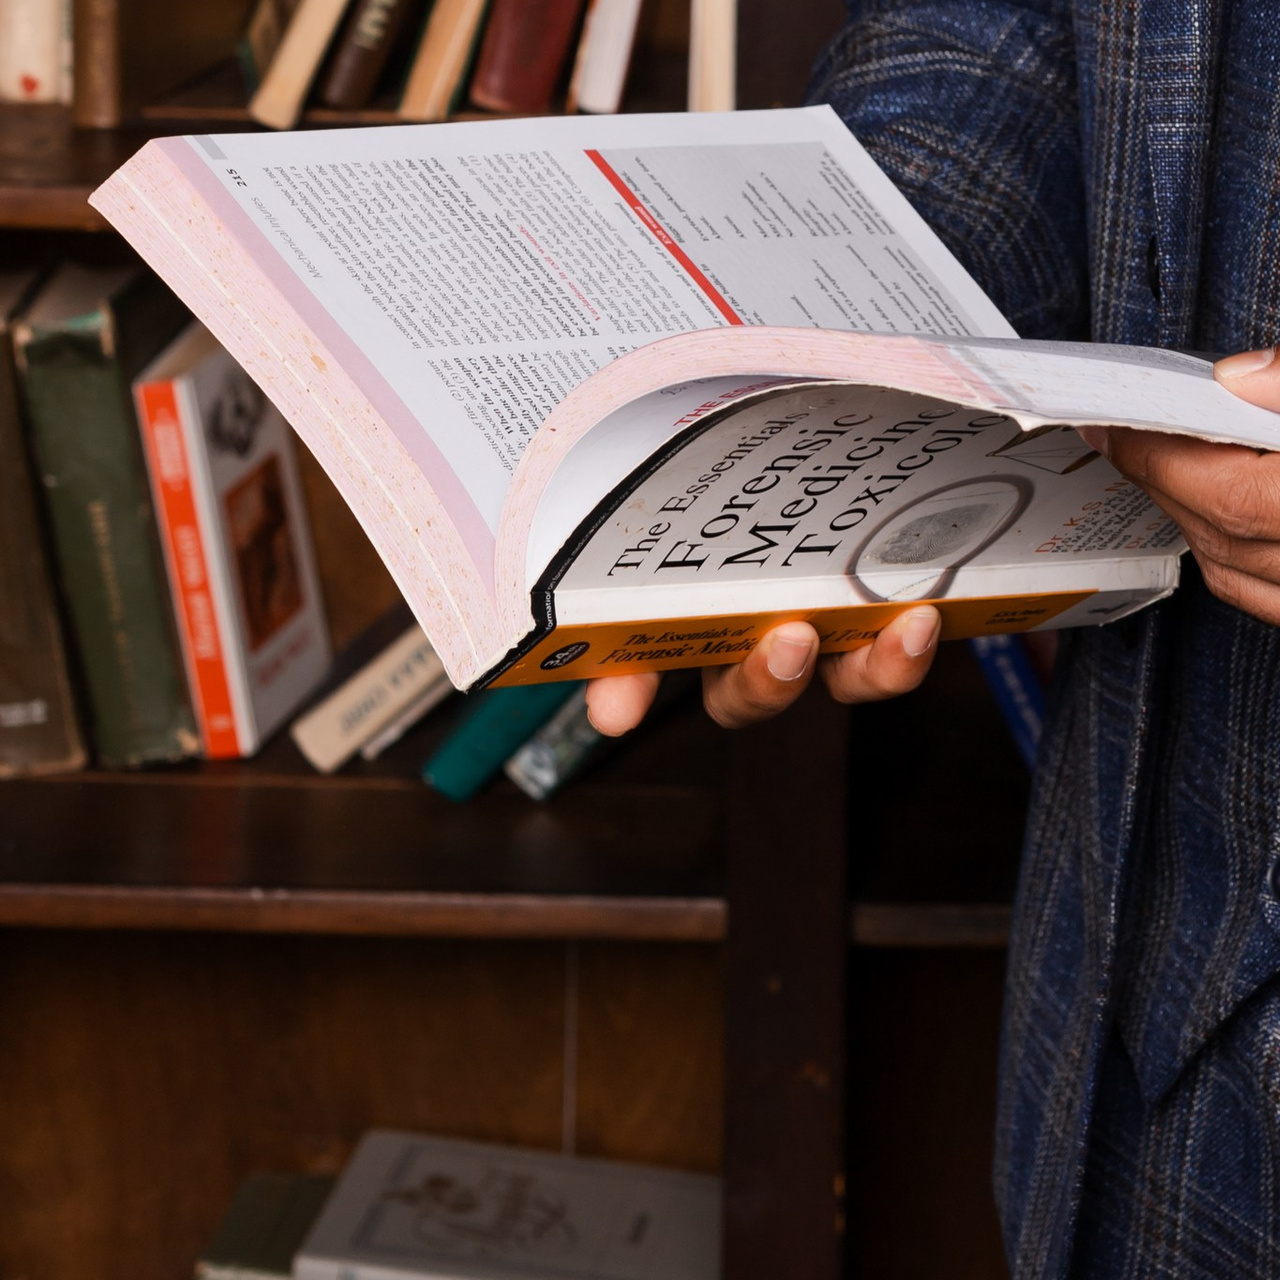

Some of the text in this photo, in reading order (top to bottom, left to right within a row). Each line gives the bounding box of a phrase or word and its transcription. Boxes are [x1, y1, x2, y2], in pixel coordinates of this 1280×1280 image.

[226, 169, 322, 278] Mechanical Injuries 215
[607, 521, 671, 576] The
[657, 412, 809, 515] Essentials
[654, 414, 873, 573] Forensic
[718, 407, 958, 570] Medicine
[781, 415, 1008, 567] Toxicolo
[597, 643, 694, 665] Forensic
[693, 637, 760, 655] Medic
[624, 634, 652, 646] The
[655, 626, 730, 643] Essentials
